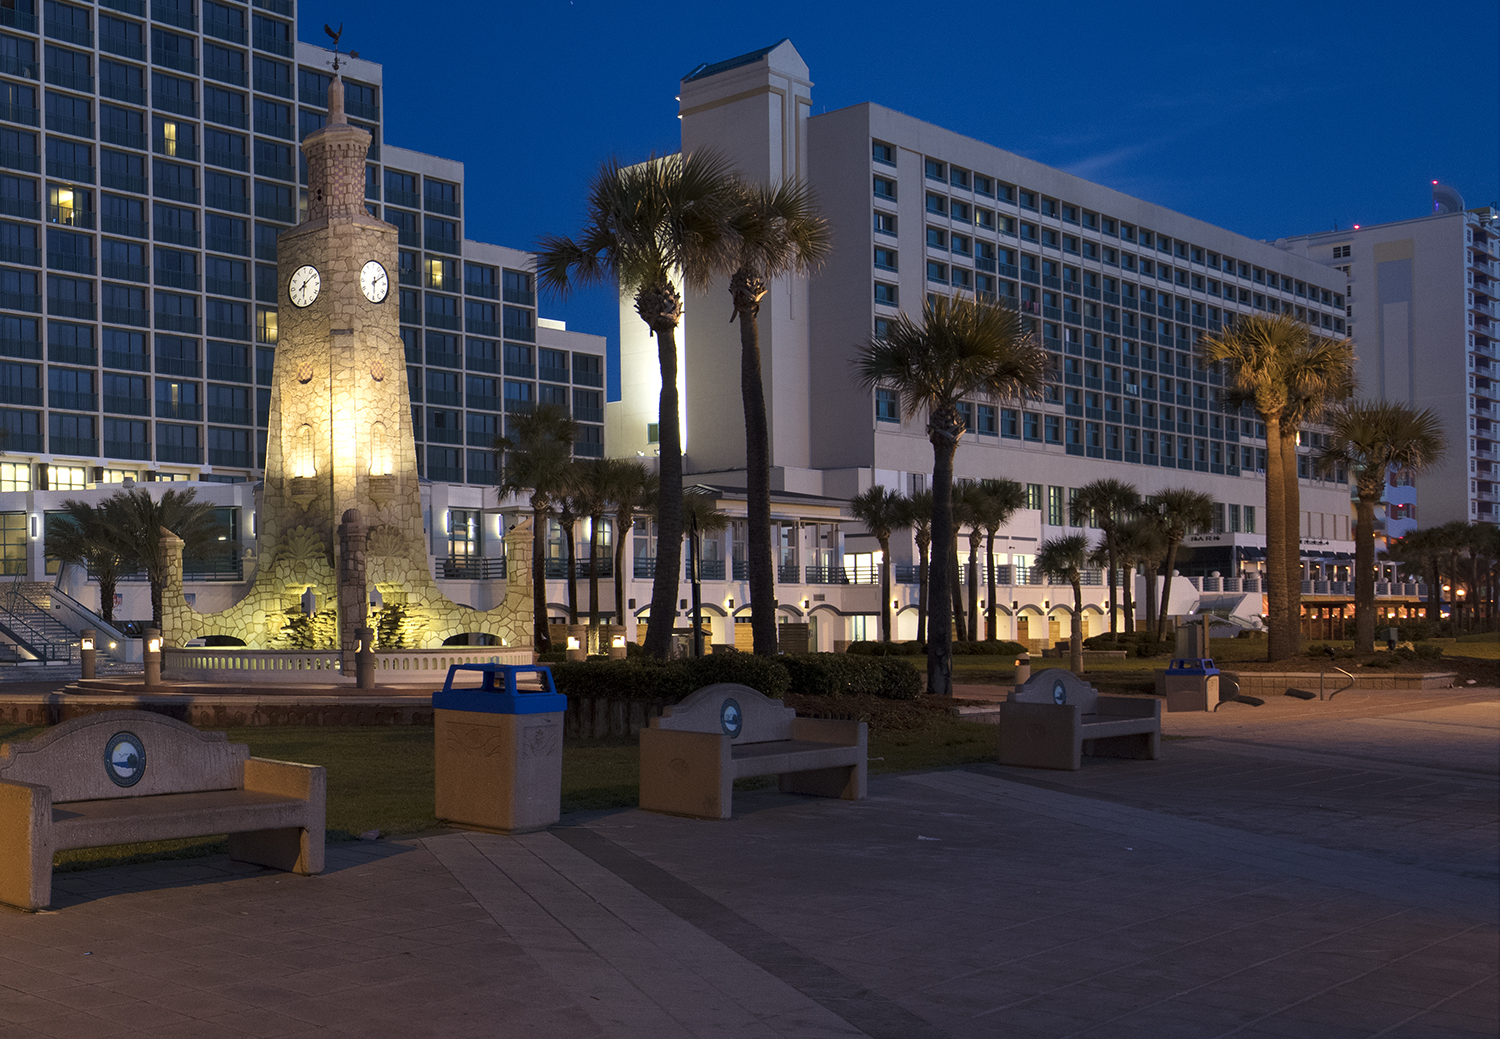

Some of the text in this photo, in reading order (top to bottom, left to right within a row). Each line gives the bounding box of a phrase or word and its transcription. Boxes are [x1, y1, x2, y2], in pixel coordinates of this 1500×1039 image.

[291, 267, 320, 292] DAYTONA
[361, 262, 387, 287] DAYTONA
[292, 288, 318, 305] BEACH
[362, 285, 385, 301] BEACH
